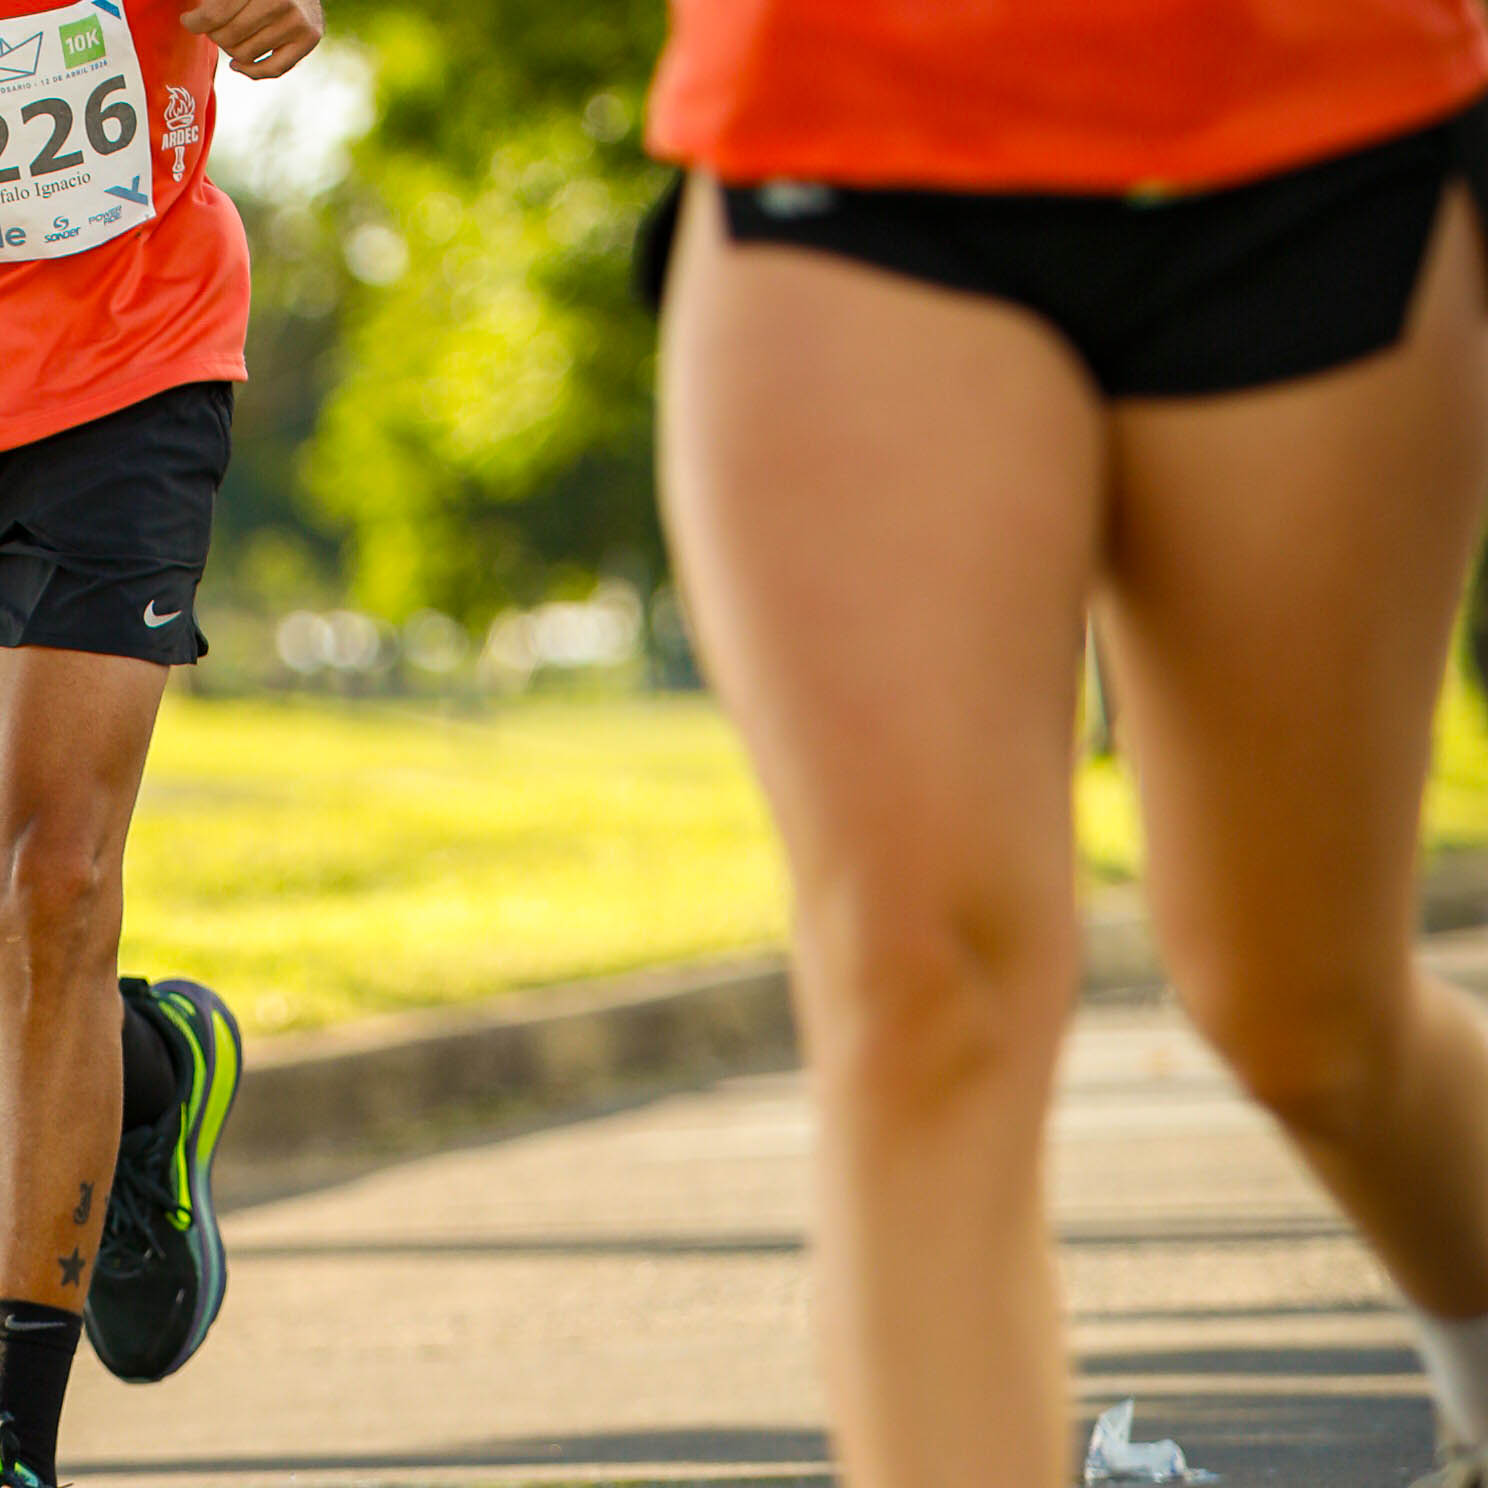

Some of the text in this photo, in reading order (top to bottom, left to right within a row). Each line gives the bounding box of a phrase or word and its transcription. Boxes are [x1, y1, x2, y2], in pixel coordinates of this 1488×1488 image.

[65, 27, 101, 56] 10K
[40, 77, 50, 86] 12
[53, 75, 63, 83] DE
[66, 67, 89, 79] ABRIL
[161, 125, 199, 151] ARDEC
[33, 171, 92, 198] Ignacio
